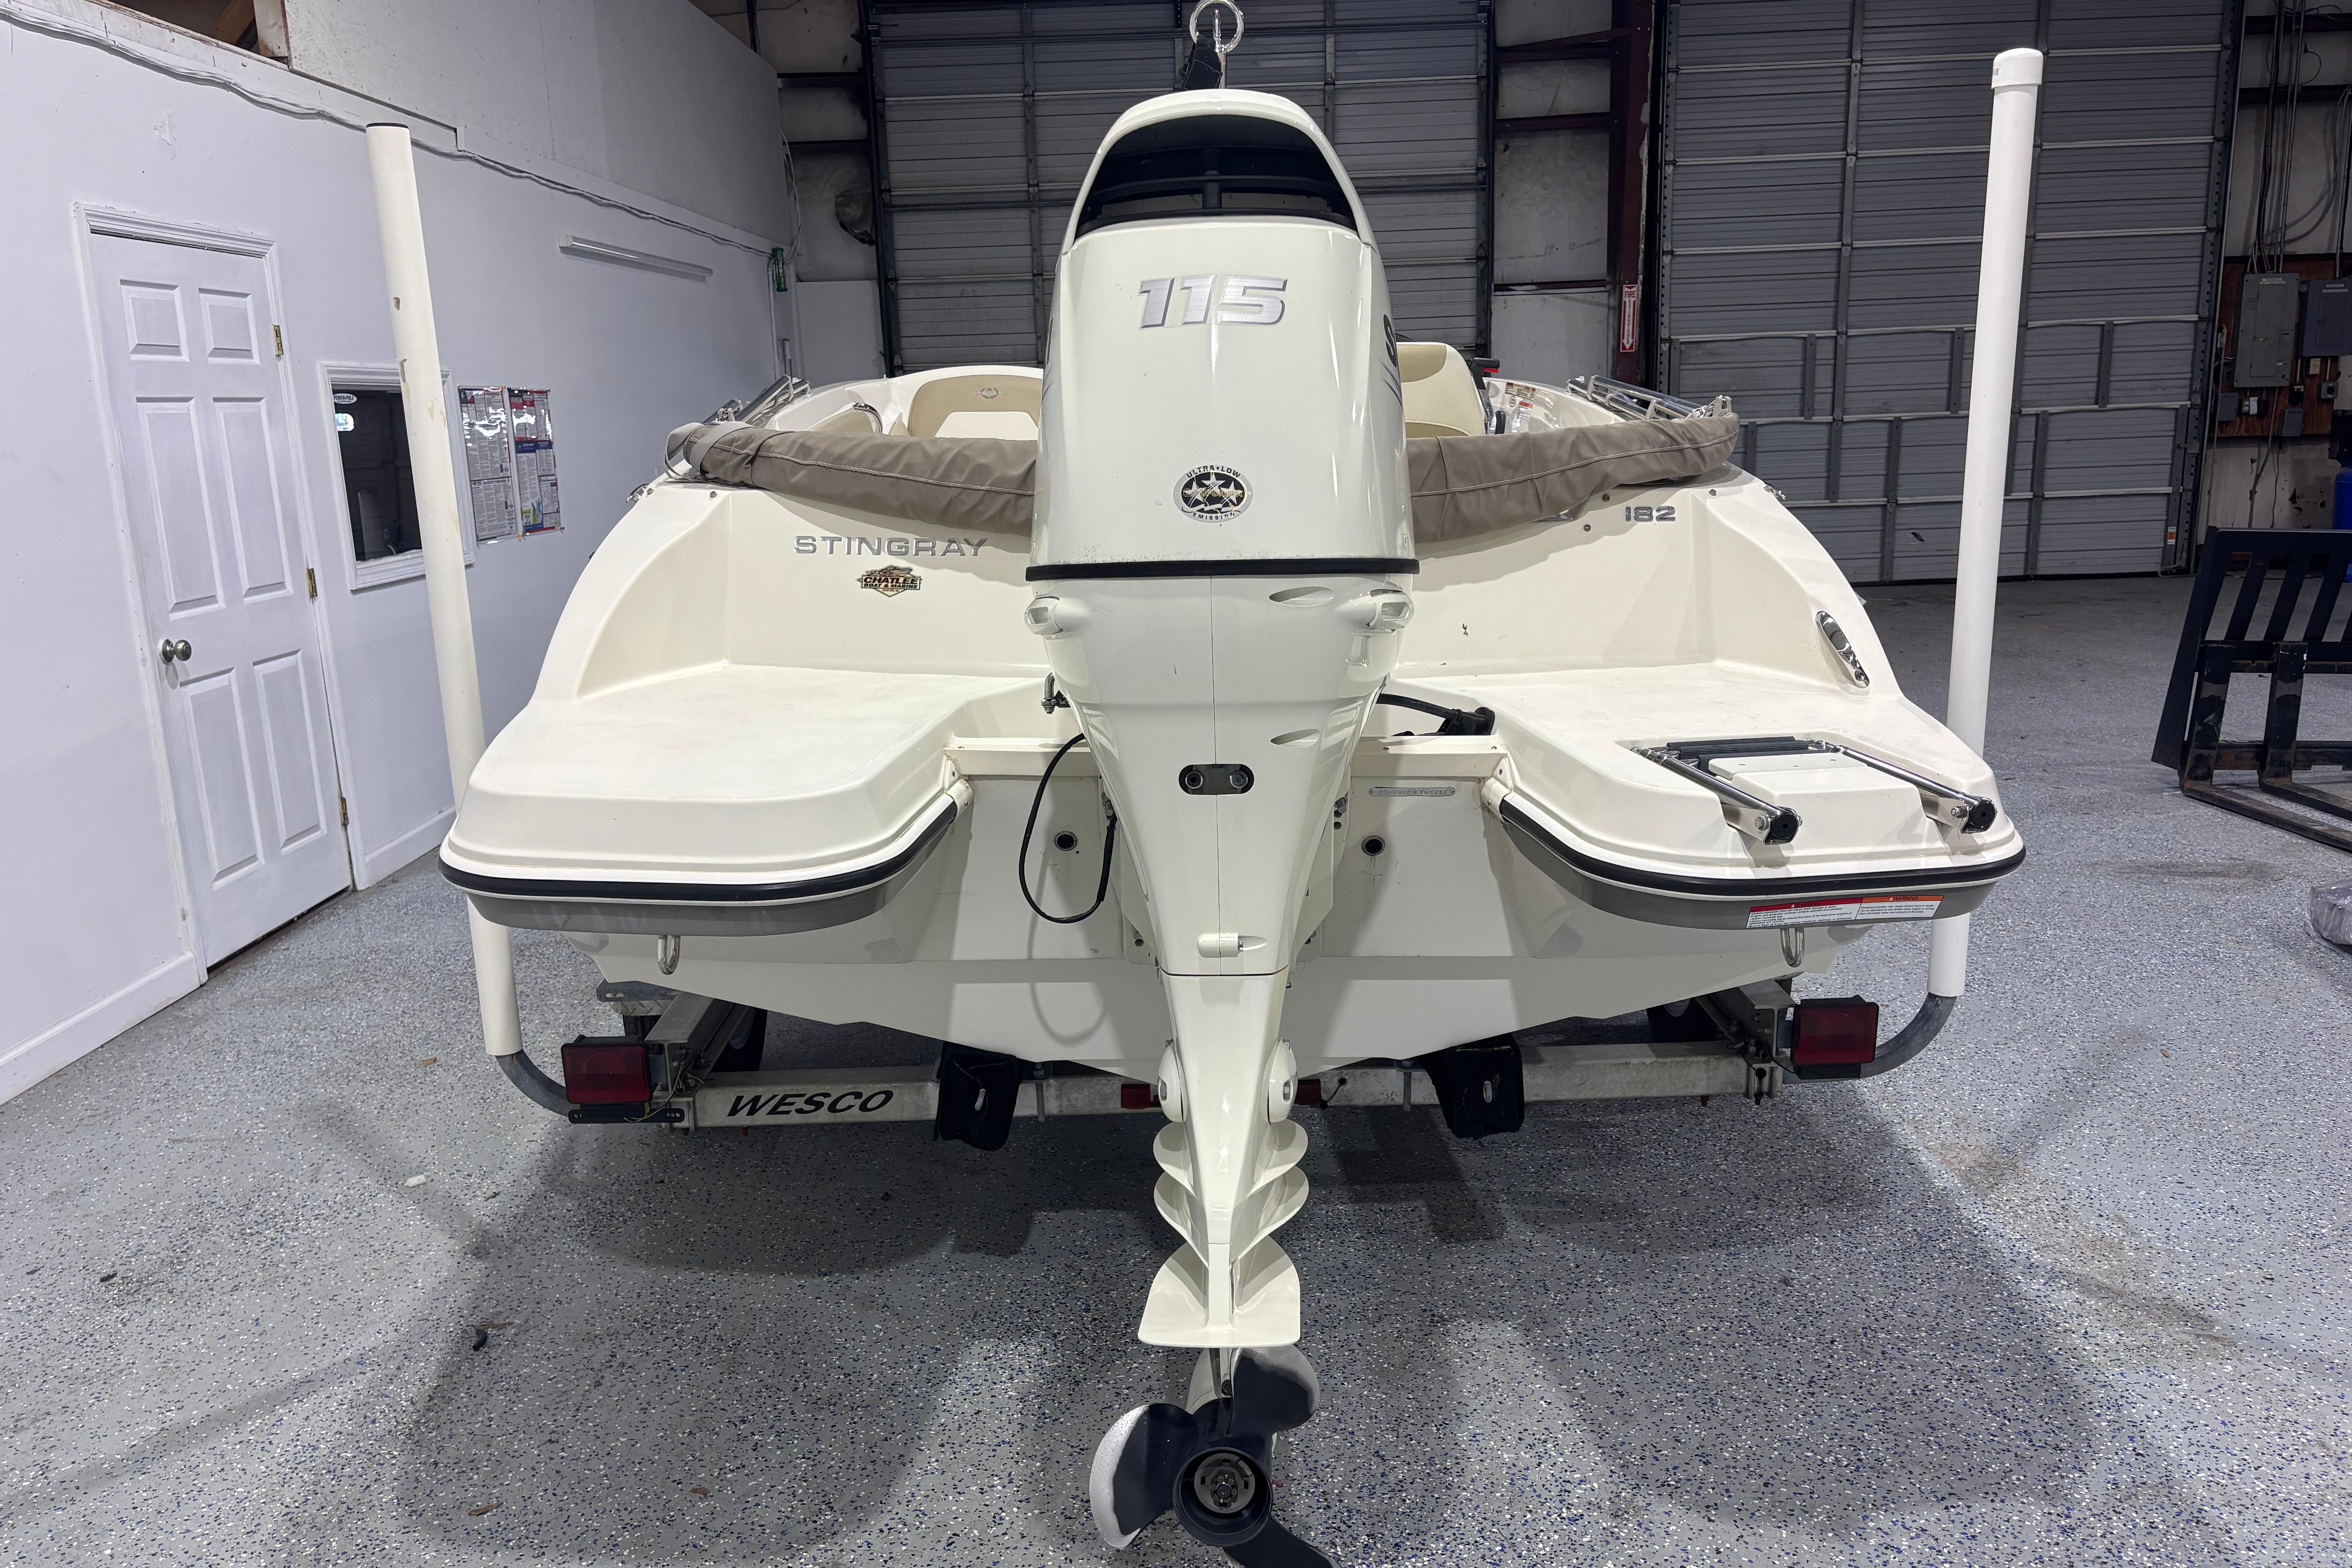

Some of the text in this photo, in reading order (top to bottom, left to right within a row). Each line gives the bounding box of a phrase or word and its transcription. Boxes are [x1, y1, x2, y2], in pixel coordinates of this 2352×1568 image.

[1138, 275, 1288, 329] 115
[1186, 465, 1241, 478] ULTRA LOW
[1192, 512, 1235, 520] EMISSION
[1625, 506, 1676, 522] 182
[793, 536, 987, 556] STINGRAY
[727, 1090, 894, 1117] WESCO
